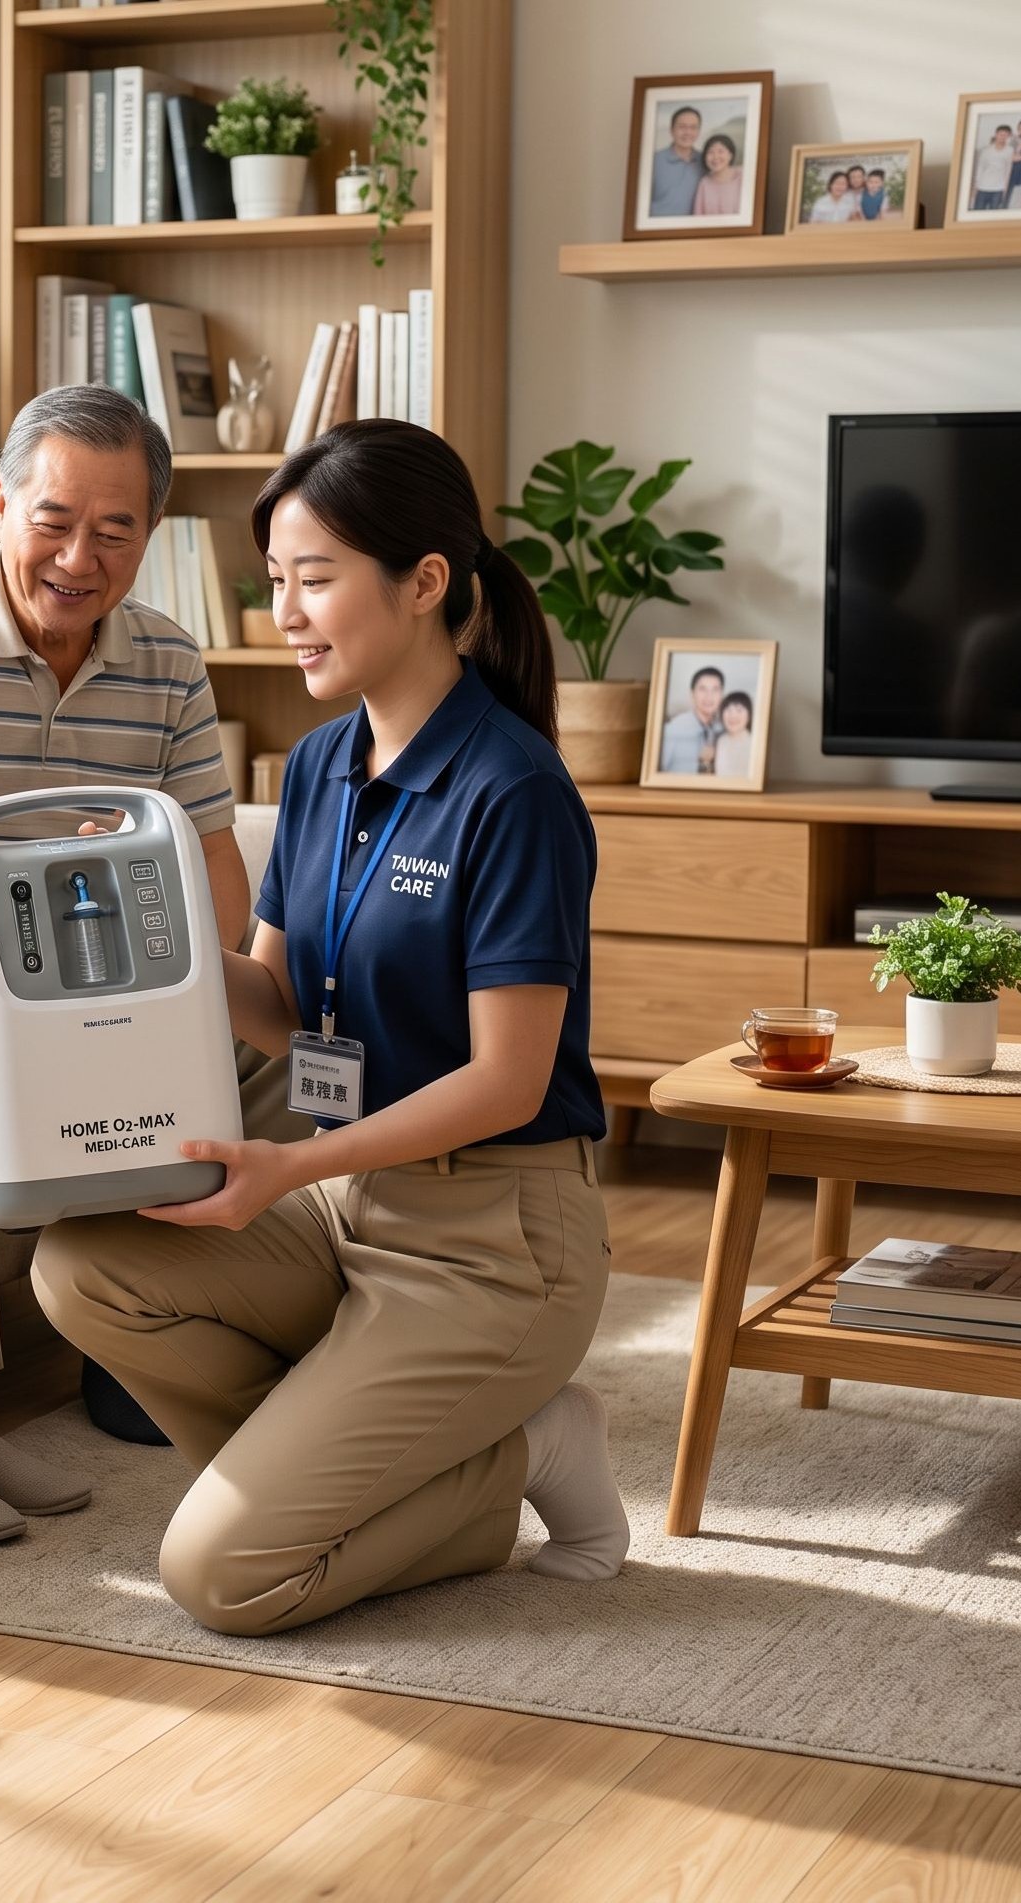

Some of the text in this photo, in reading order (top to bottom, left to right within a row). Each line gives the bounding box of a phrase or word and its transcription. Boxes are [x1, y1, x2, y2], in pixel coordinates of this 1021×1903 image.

[390, 875, 434, 898] CARE
[60, 1120, 109, 1139] HOME
[84, 1134, 156, 1154] MEDI-CARE
